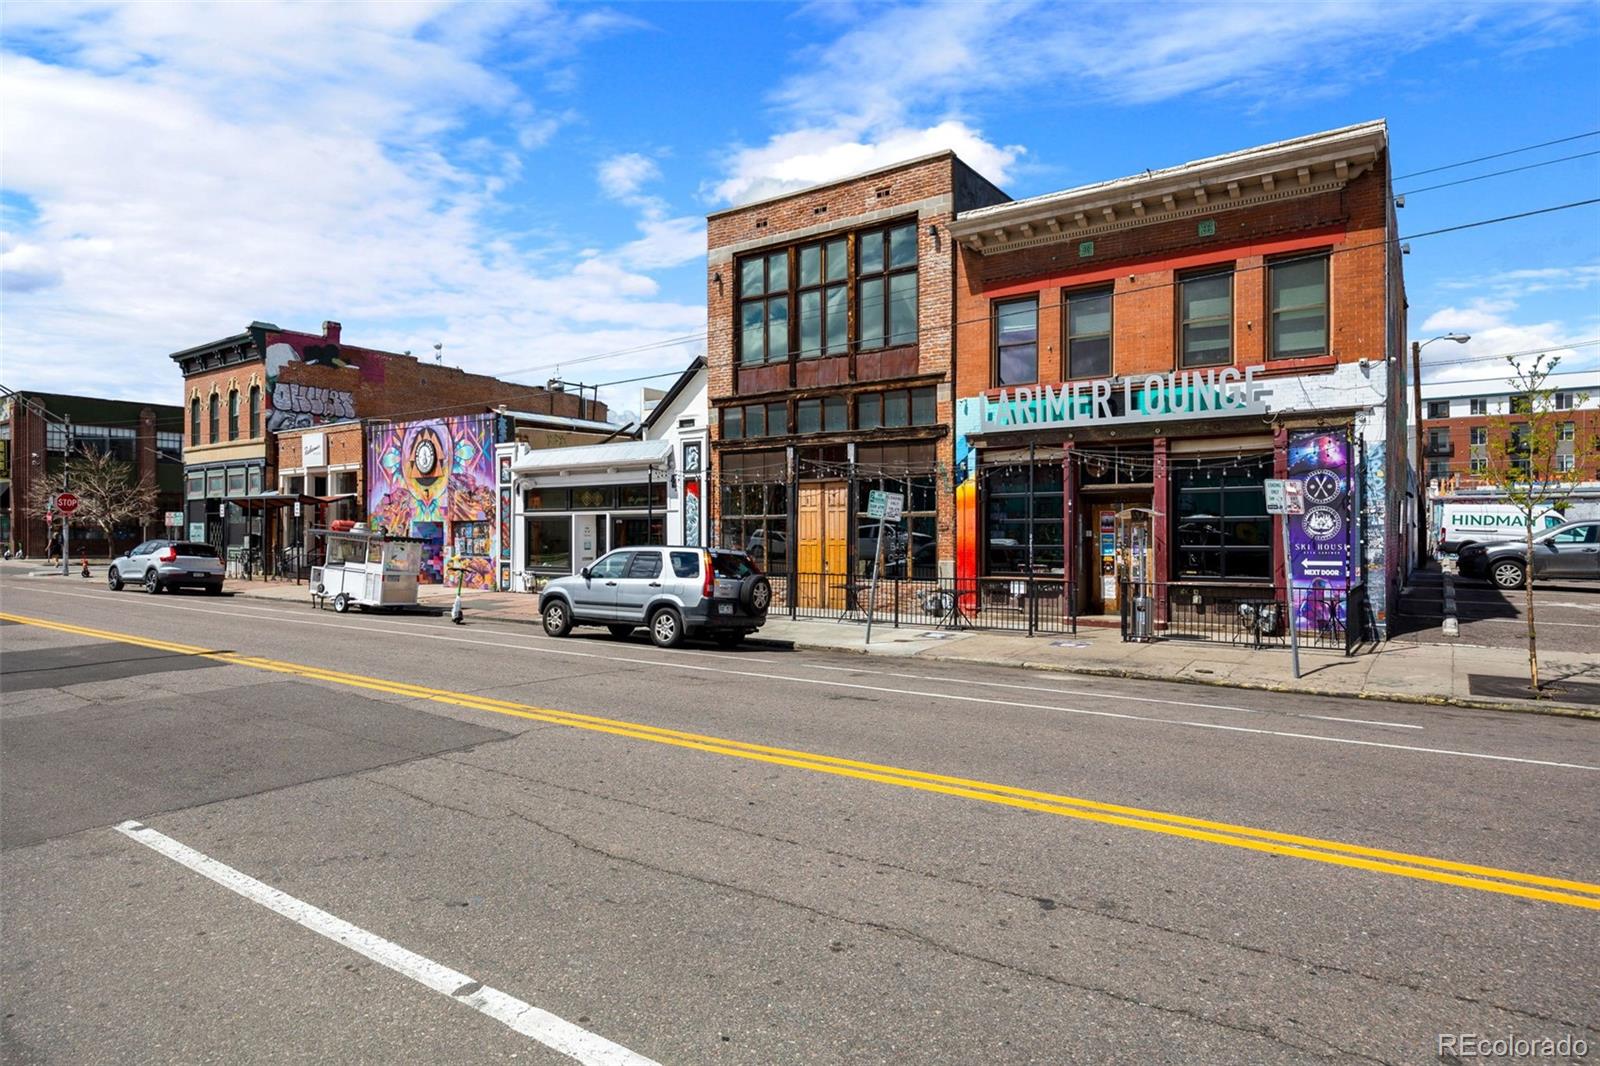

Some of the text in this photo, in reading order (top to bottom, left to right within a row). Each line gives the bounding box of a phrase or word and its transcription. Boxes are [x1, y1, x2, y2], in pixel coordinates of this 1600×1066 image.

[979, 365, 1265, 427] LARIMER LOUNGE
[58, 499, 77, 507] STOP
[1452, 514, 1537, 528] HINDMAN
[1295, 543, 1310, 551] SKI
